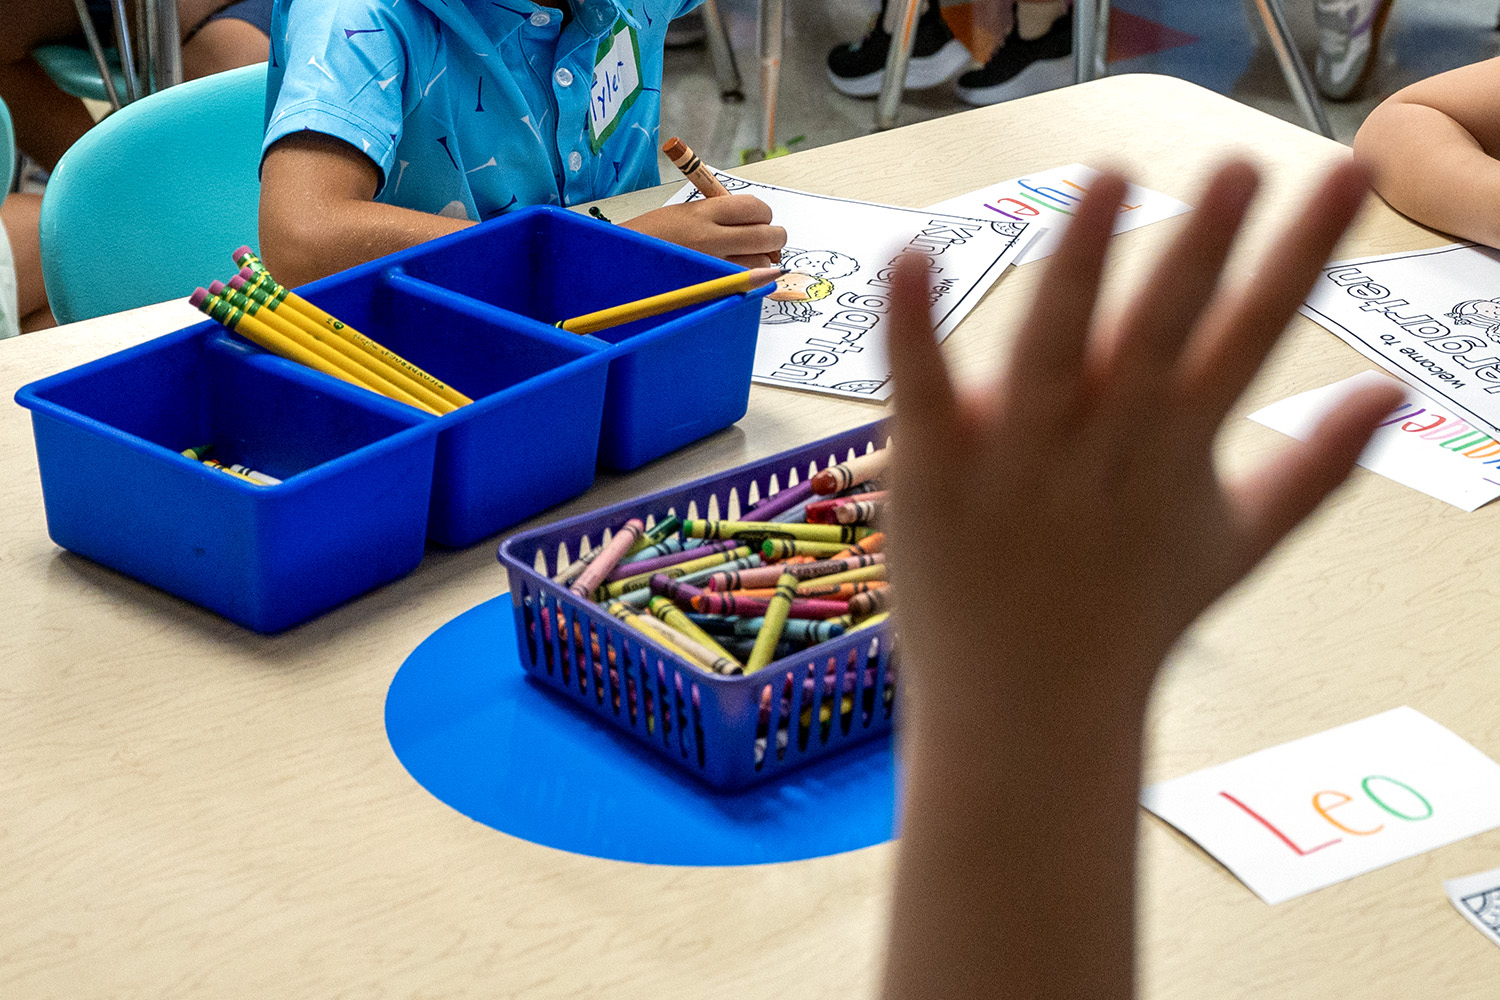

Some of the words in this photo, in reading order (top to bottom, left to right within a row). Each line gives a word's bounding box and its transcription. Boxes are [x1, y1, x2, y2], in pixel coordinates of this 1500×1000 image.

[1380, 333, 1402, 347] to
[1399, 346, 1467, 390] welcome
[1218, 775, 1434, 856] Leo
